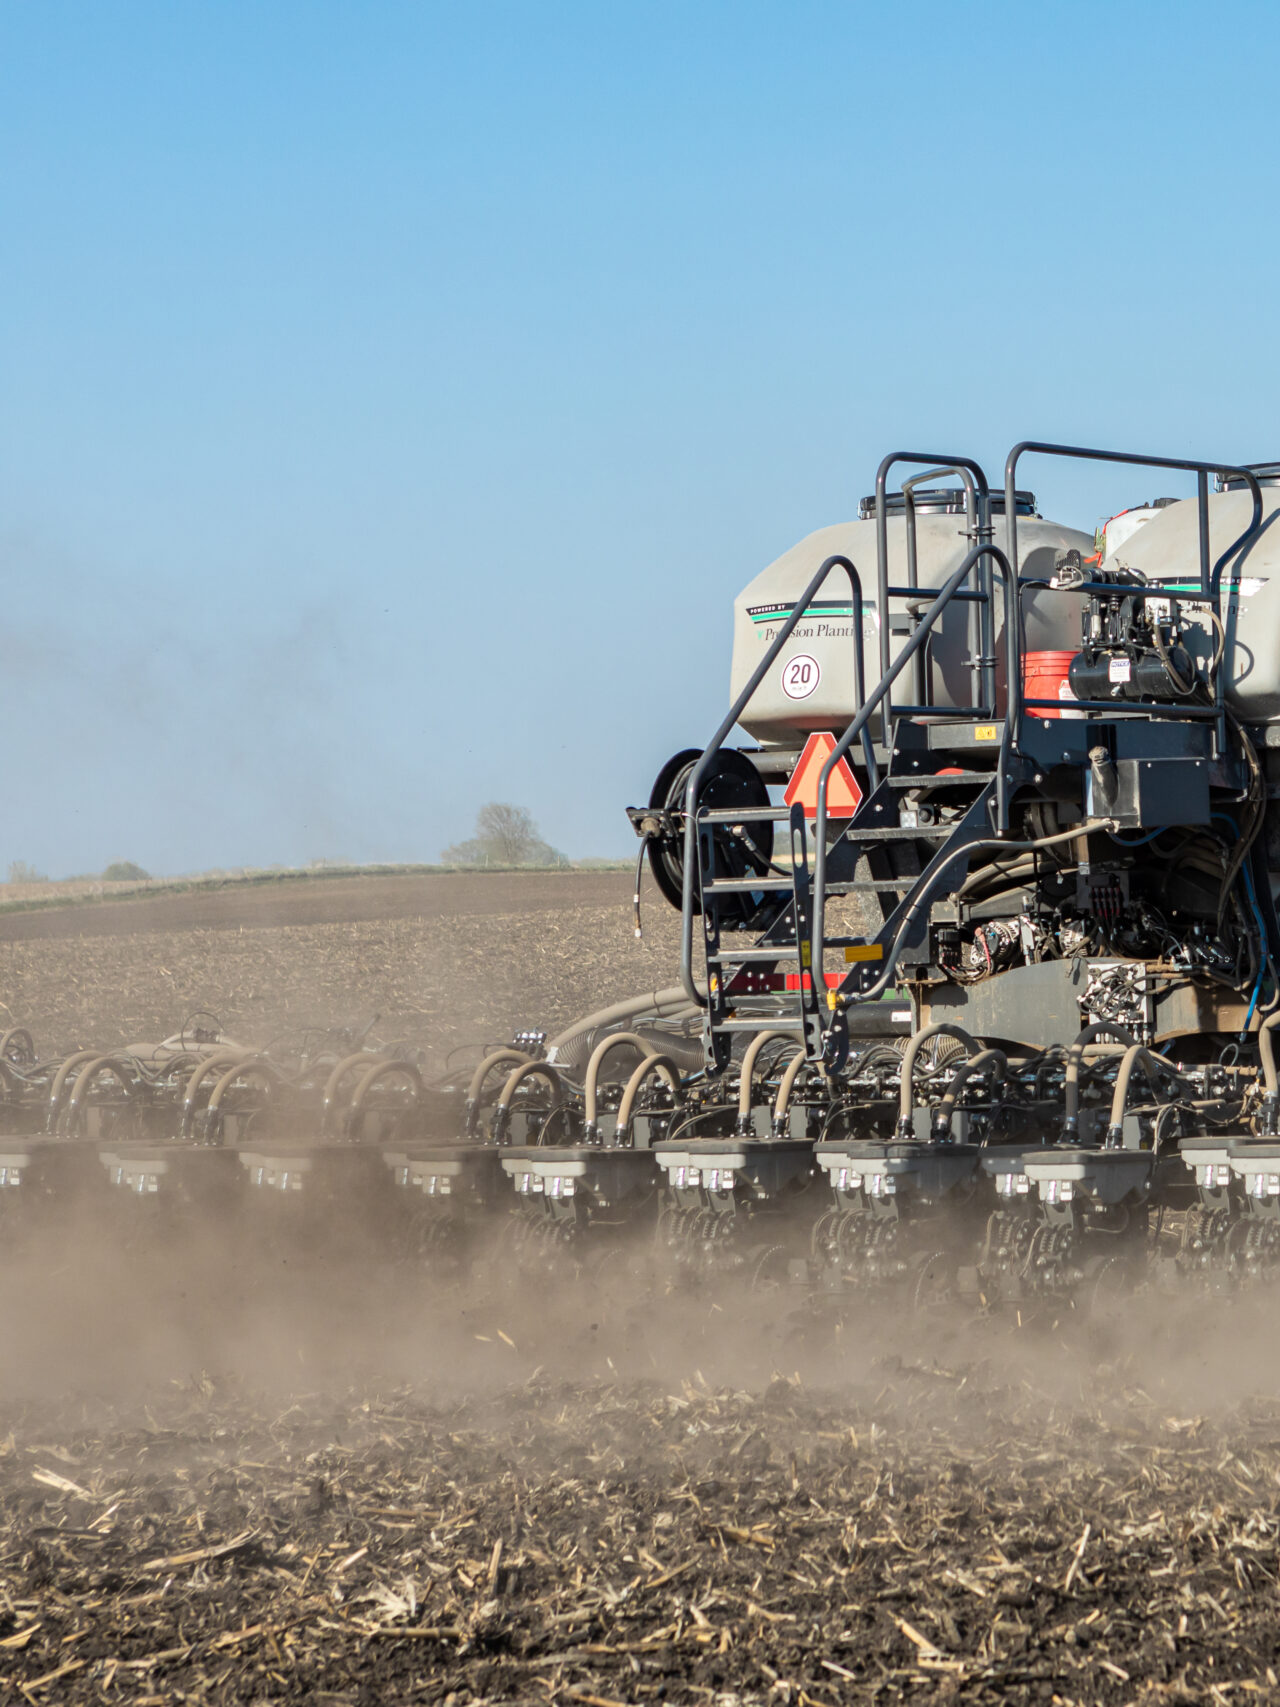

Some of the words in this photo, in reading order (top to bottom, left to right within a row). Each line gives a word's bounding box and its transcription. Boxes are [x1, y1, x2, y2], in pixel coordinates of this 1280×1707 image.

[750, 606, 776, 614] POWERED
[765, 624, 814, 640] Prsion
[791, 664, 811, 684] 20
